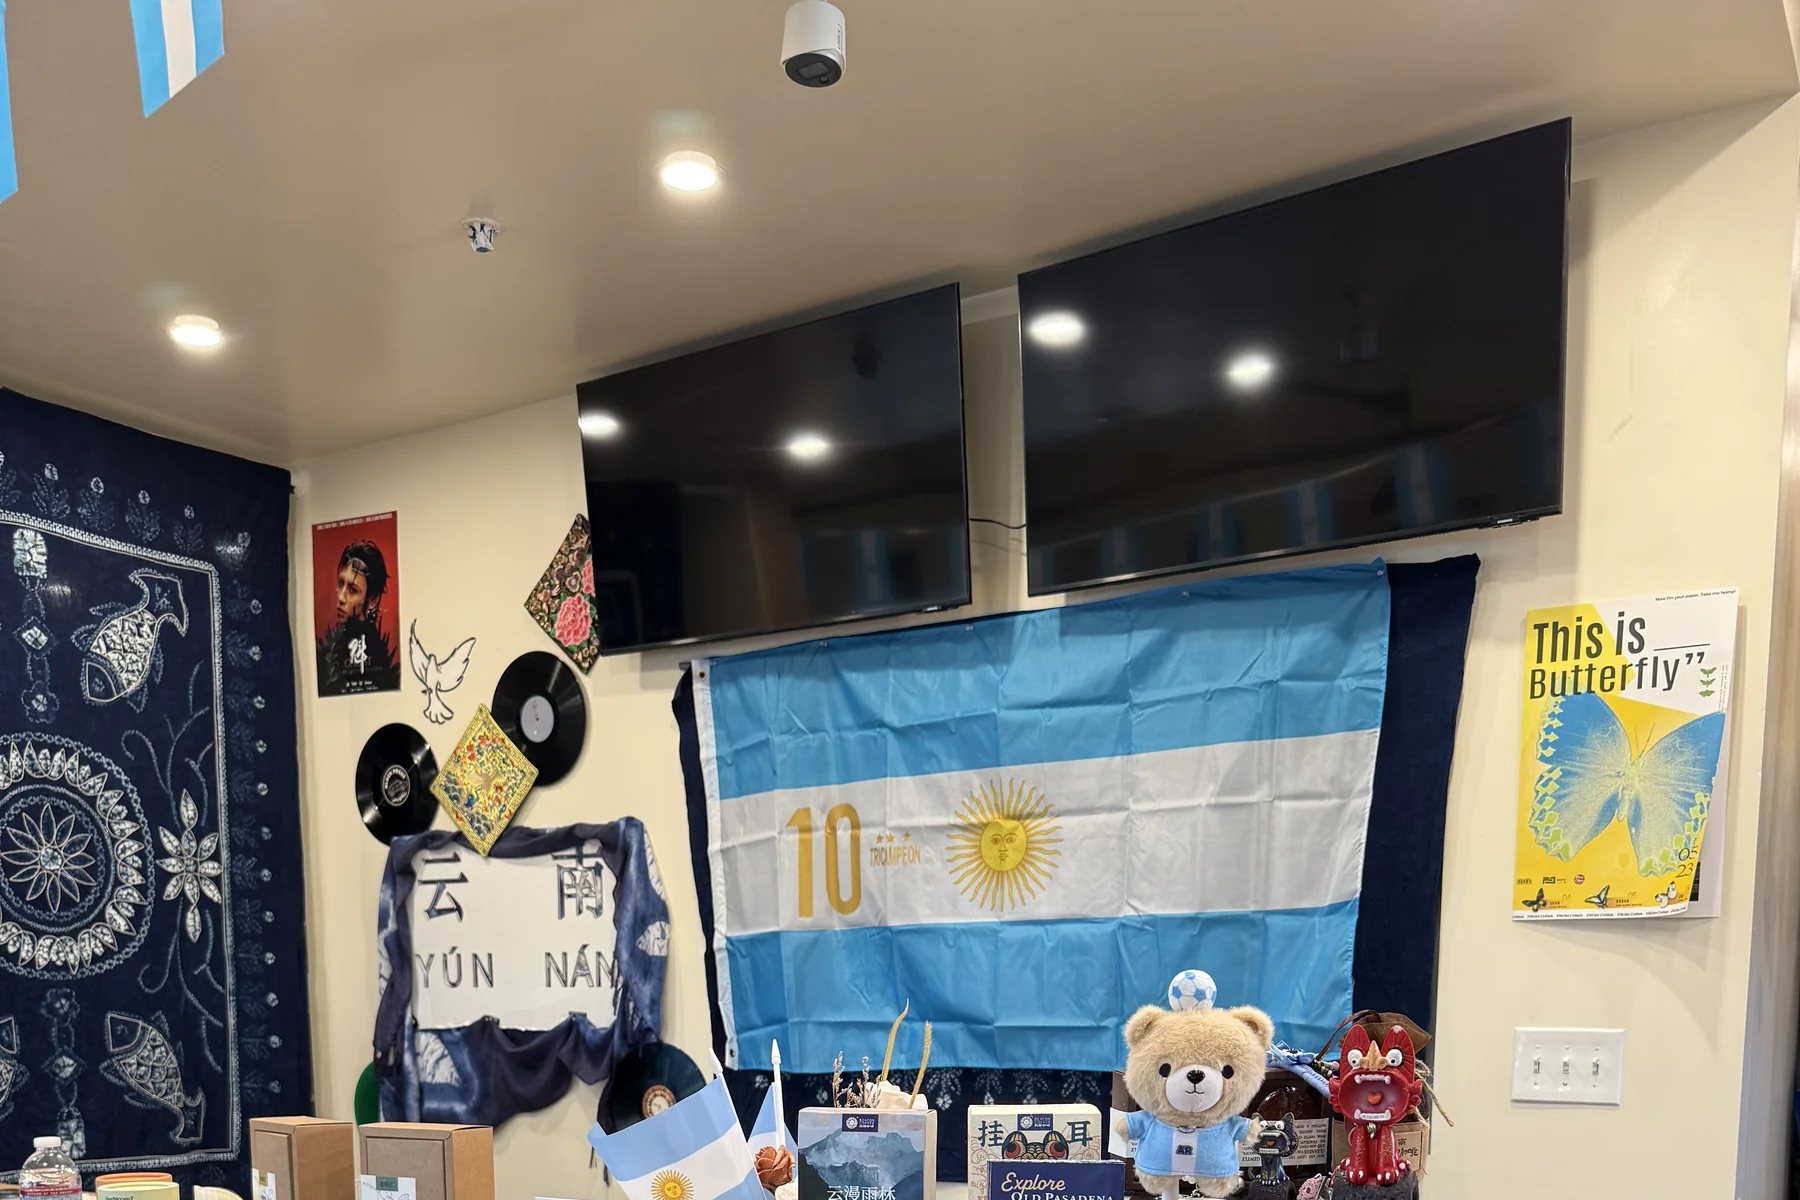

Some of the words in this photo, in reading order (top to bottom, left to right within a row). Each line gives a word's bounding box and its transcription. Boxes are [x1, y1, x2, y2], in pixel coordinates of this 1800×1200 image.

[1533, 616, 1603, 664] This
[1615, 611, 1646, 656] is
[786, 803, 862, 918] 10
[1679, 845, 1699, 861] 05
[1675, 862, 1694, 878] 23
[418, 851, 469, 923] 云
[550, 845, 604, 920] 南
[415, 946, 495, 989] YÚN
[978, 1120, 1004, 1147] 挂
[1066, 1120, 1093, 1147] 耳
[1175, 1144, 1193, 1156] AR
[1001, 1172, 1066, 1198] Explore
